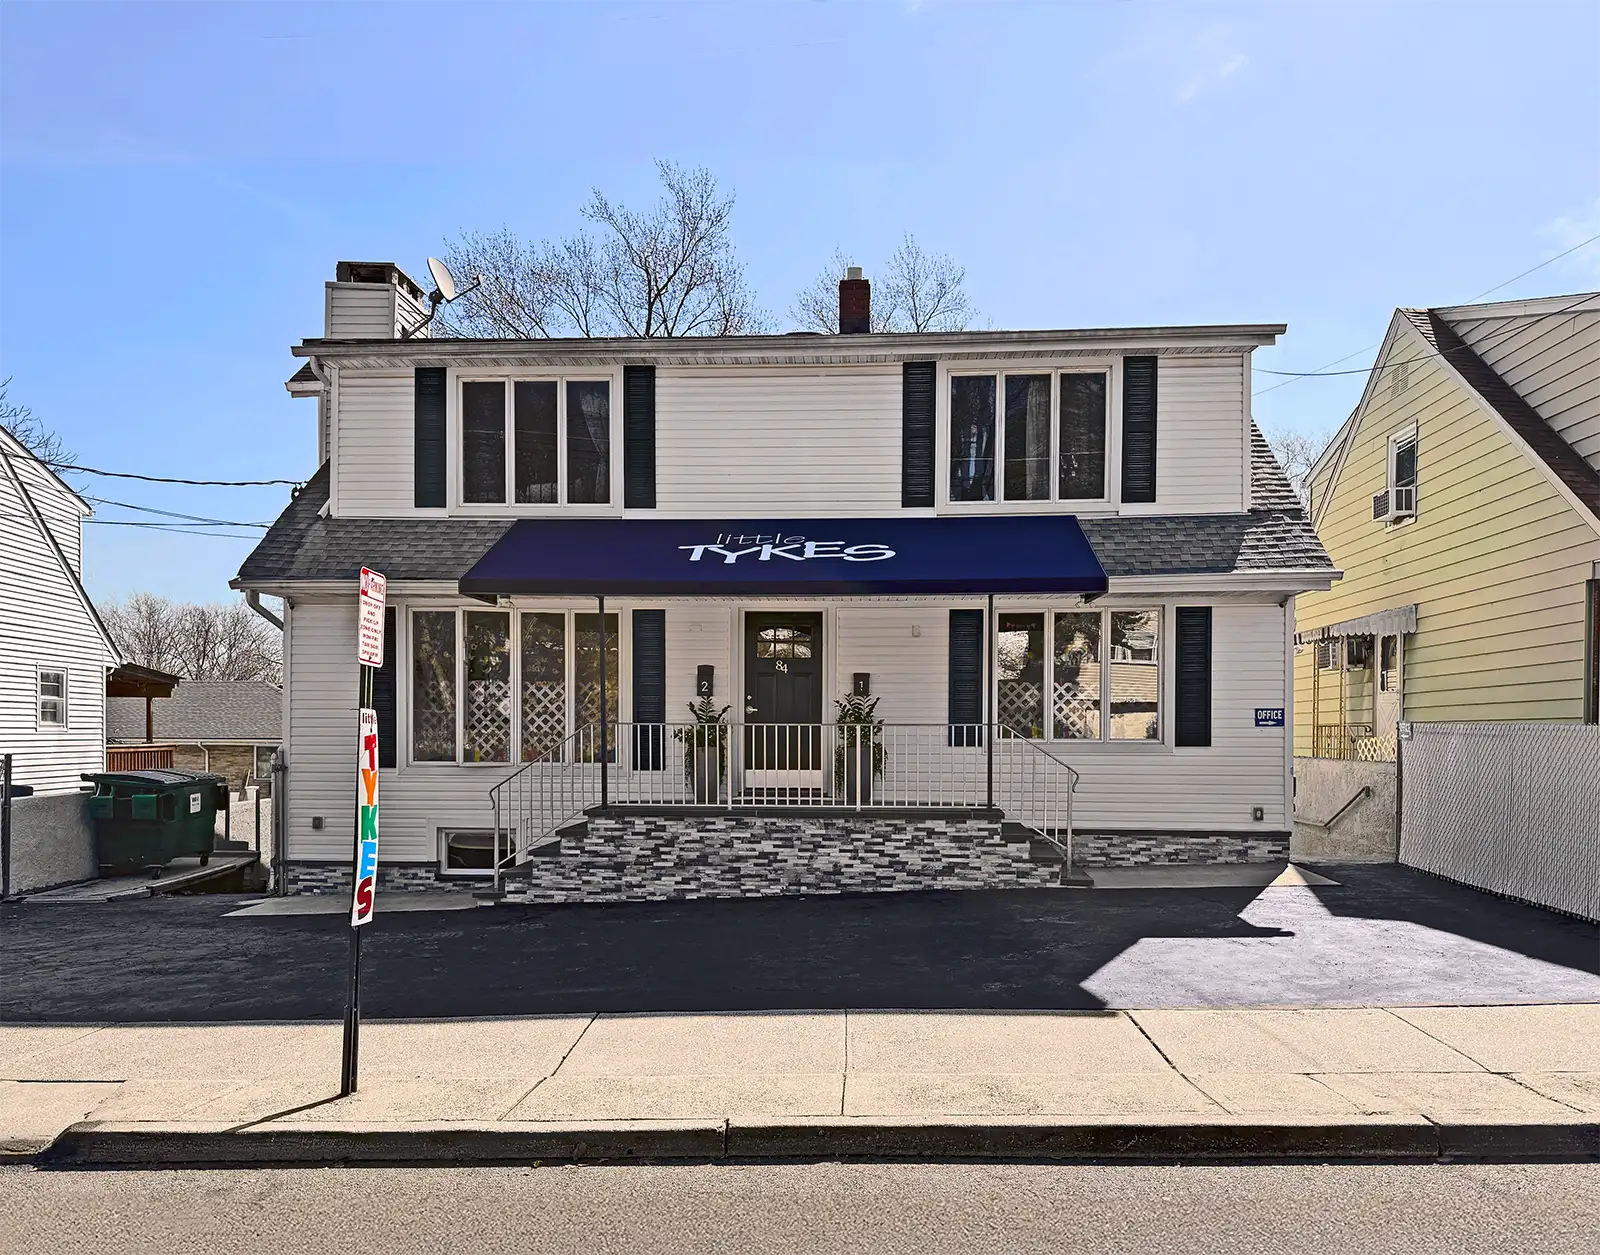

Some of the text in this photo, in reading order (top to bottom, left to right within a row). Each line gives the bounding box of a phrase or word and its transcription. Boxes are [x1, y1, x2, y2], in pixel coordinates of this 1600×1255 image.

[716, 533, 806, 545] little
[678, 541, 897, 564] TYKES
[775, 660, 788, 674] 84
[701, 681, 709, 692] 2
[1257, 710, 1283, 720] OFFICE
[357, 734, 378, 921] TYKES
